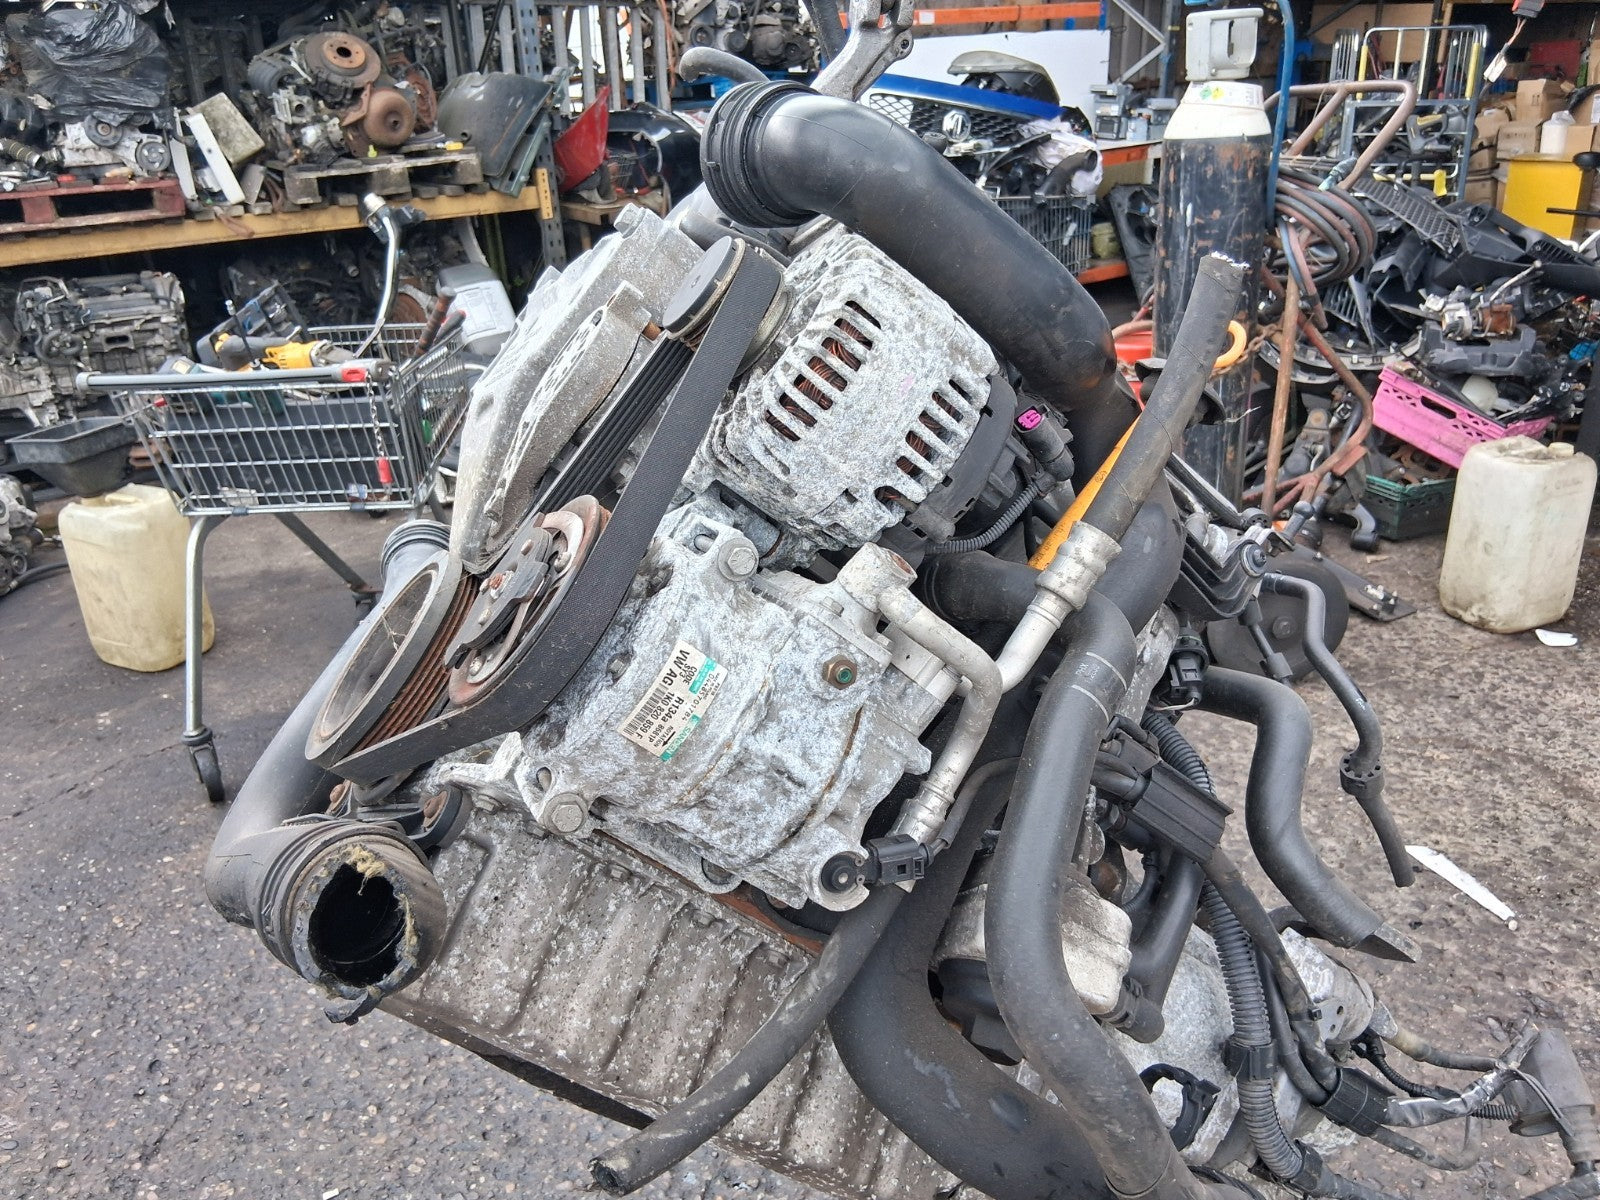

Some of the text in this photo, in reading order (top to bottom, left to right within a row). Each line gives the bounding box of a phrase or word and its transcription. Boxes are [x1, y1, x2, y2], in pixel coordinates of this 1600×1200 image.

[662, 648, 690, 687] VW AG
[679, 663, 691, 678] SY3
[682, 666, 698, 686] CODE
[635, 691, 675, 740] 1K0 820 859 F
[661, 696, 684, 724] R134a
[654, 725, 673, 748] ROTATION
[666, 726, 691, 755] SANDEN
